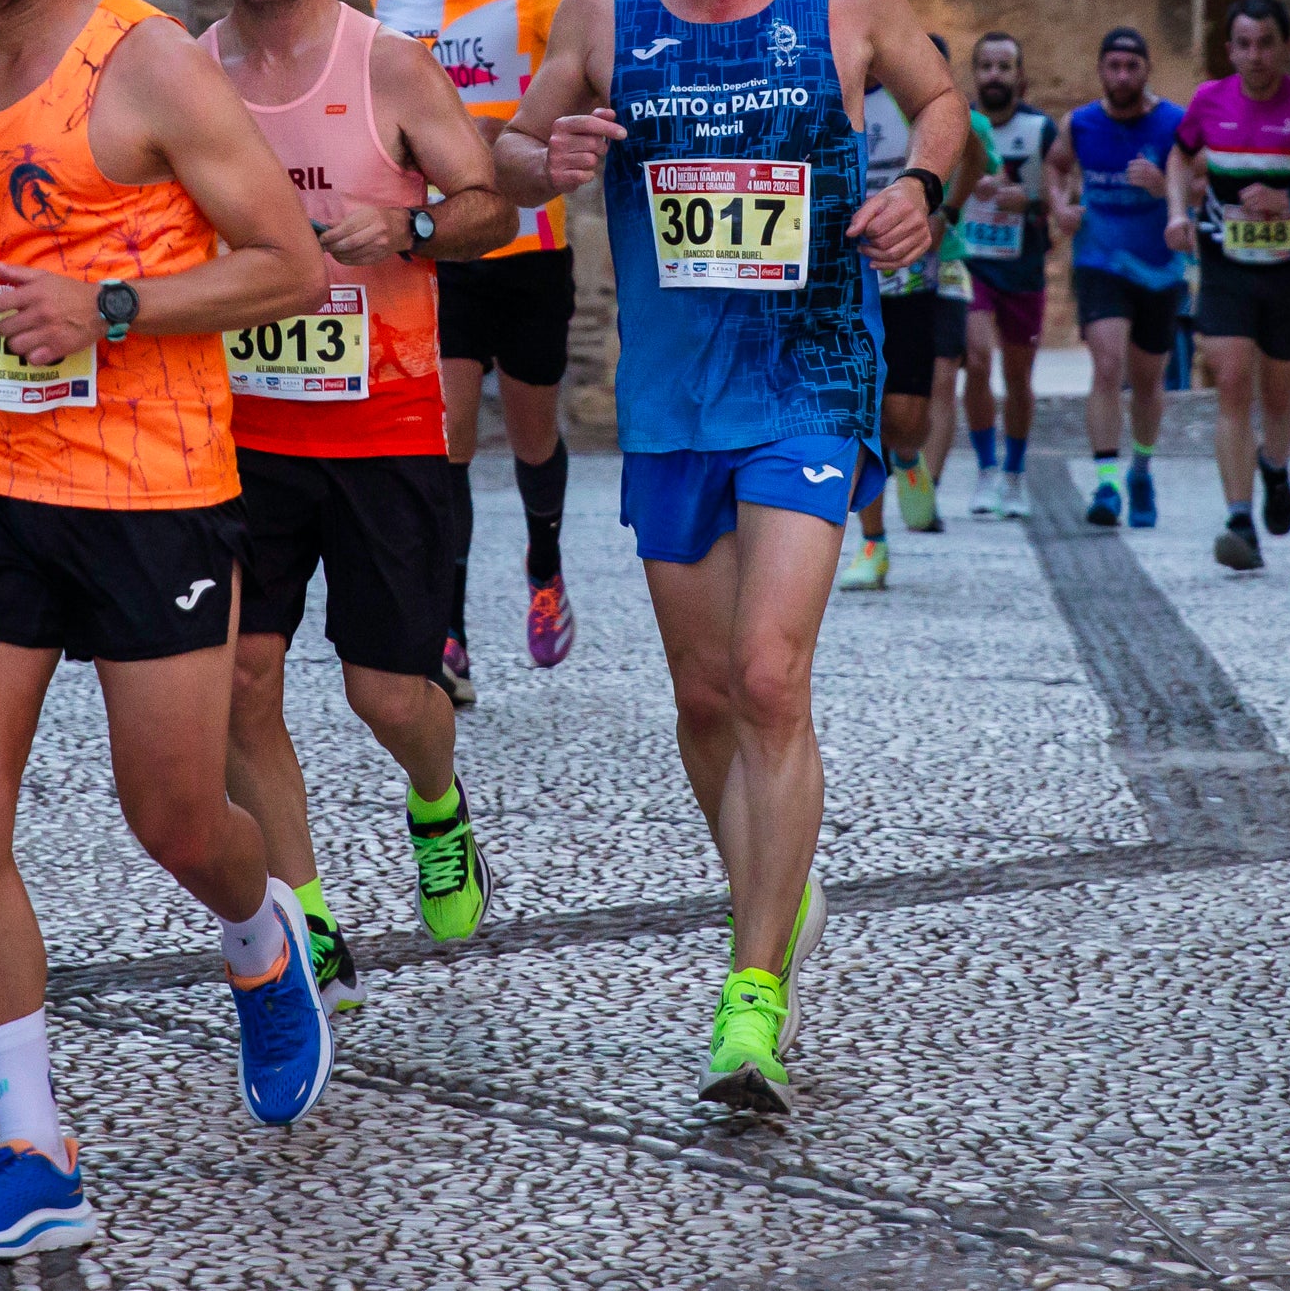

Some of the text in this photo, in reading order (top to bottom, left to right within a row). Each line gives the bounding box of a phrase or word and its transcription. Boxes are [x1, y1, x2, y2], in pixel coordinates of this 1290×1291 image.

[670, 78, 768, 93] Asociación Deportiva
[630, 87, 809, 121] PAZITO a PAZITO
[695, 120, 744, 138] Motril
[657, 166, 677, 191] 40
[677, 169, 736, 182] MEDIA MARATÓN
[677, 182, 736, 191] CIUDAD DE GRANADA
[746, 180, 753, 190] 4
[753, 180, 772, 191] MAYO
[772, 181, 790, 192] 2024
[659, 197, 786, 246] 3017
[683, 249, 764, 260] FRANCISCO GARCIA BUREL
[332, 302, 348, 314] 2024
[230, 319, 346, 362] 3013
[29, 370, 60, 382] MORAGA
[255, 365, 286, 374] ALEJANDRO
